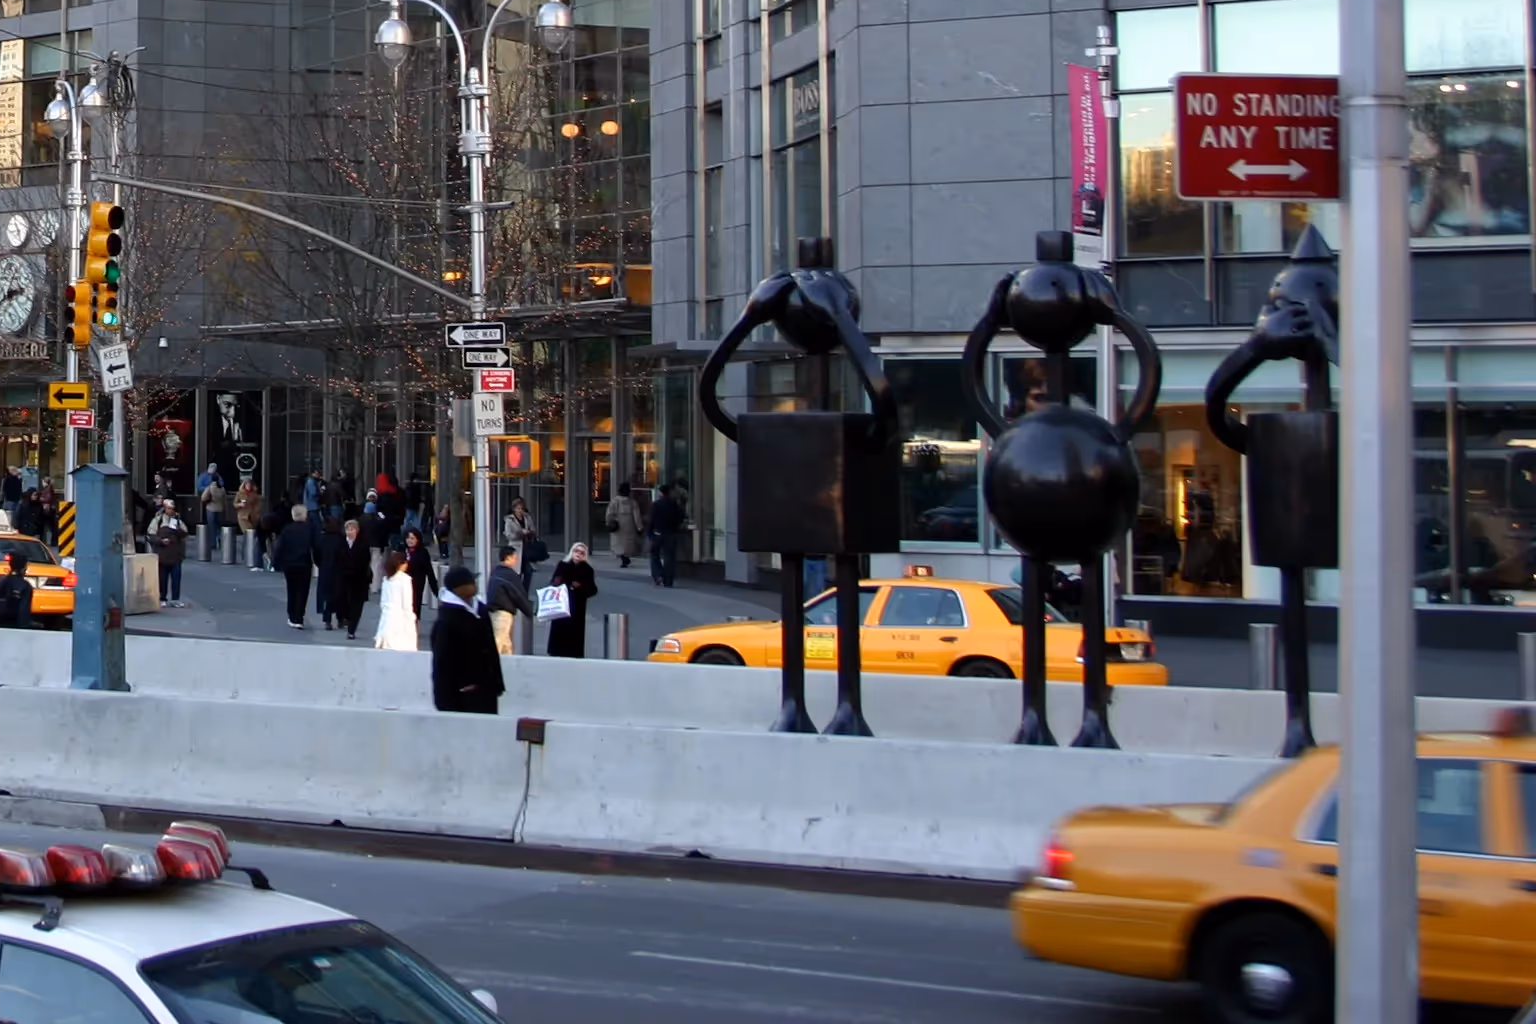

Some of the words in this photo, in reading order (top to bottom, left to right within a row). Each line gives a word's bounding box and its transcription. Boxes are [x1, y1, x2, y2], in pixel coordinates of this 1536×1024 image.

[1186, 92, 1218, 116] NO
[1232, 93, 1341, 117] STANDING
[1199, 125, 1258, 149] ANY
[1274, 126, 1334, 150] TIME
[464, 330, 479, 340] ONE
[482, 329, 498, 339] WAY
[104, 348, 123, 360] KEEP
[108, 376, 128, 388] LEFT
[481, 399, 496, 412] NO
[477, 417, 503, 429] TURNS
